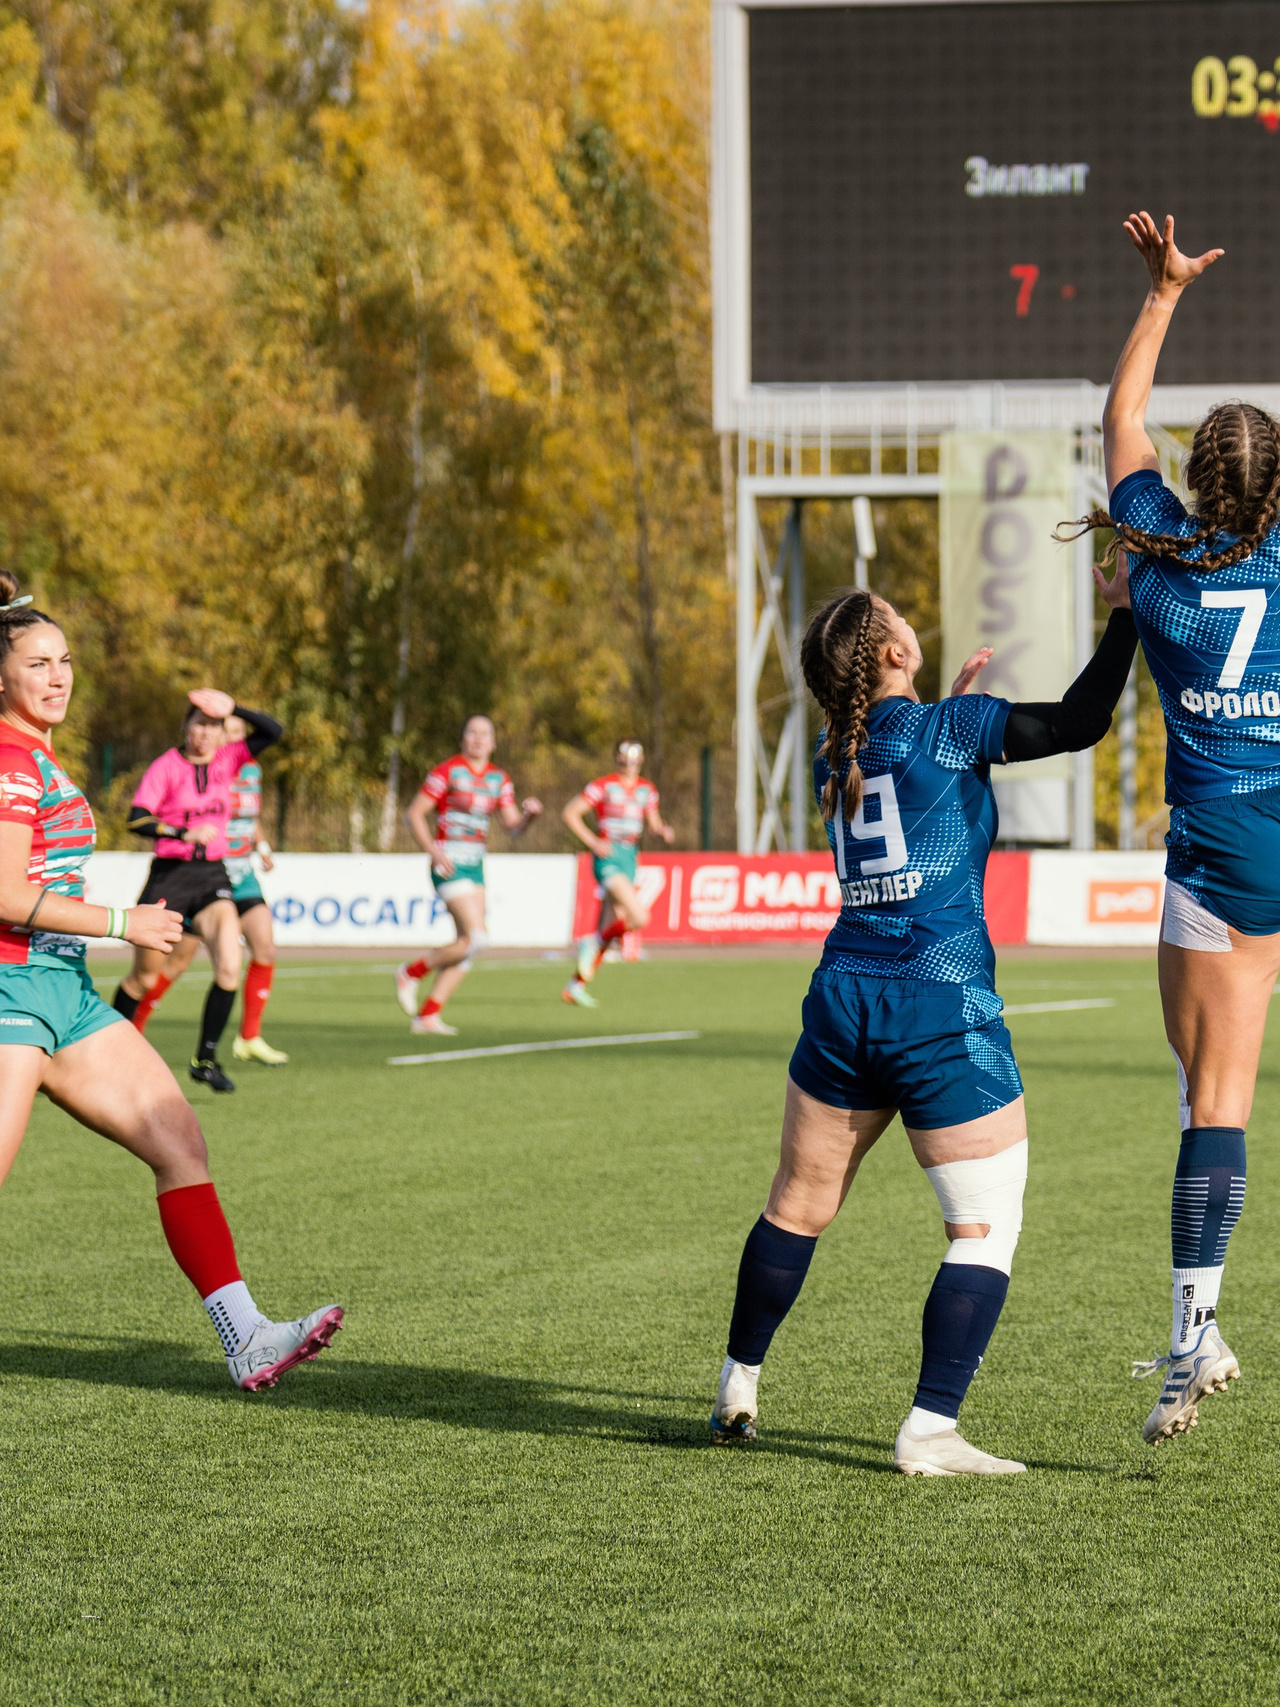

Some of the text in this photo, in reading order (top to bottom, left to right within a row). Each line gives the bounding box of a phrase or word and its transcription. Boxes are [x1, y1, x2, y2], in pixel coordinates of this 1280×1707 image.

[964, 155, 1090, 196] Зилант
[1010, 264, 1040, 316] 7
[1200, 588, 1268, 688] 7
[821, 773, 909, 880] 19
[271, 897, 448, 927] ФОСАГР
